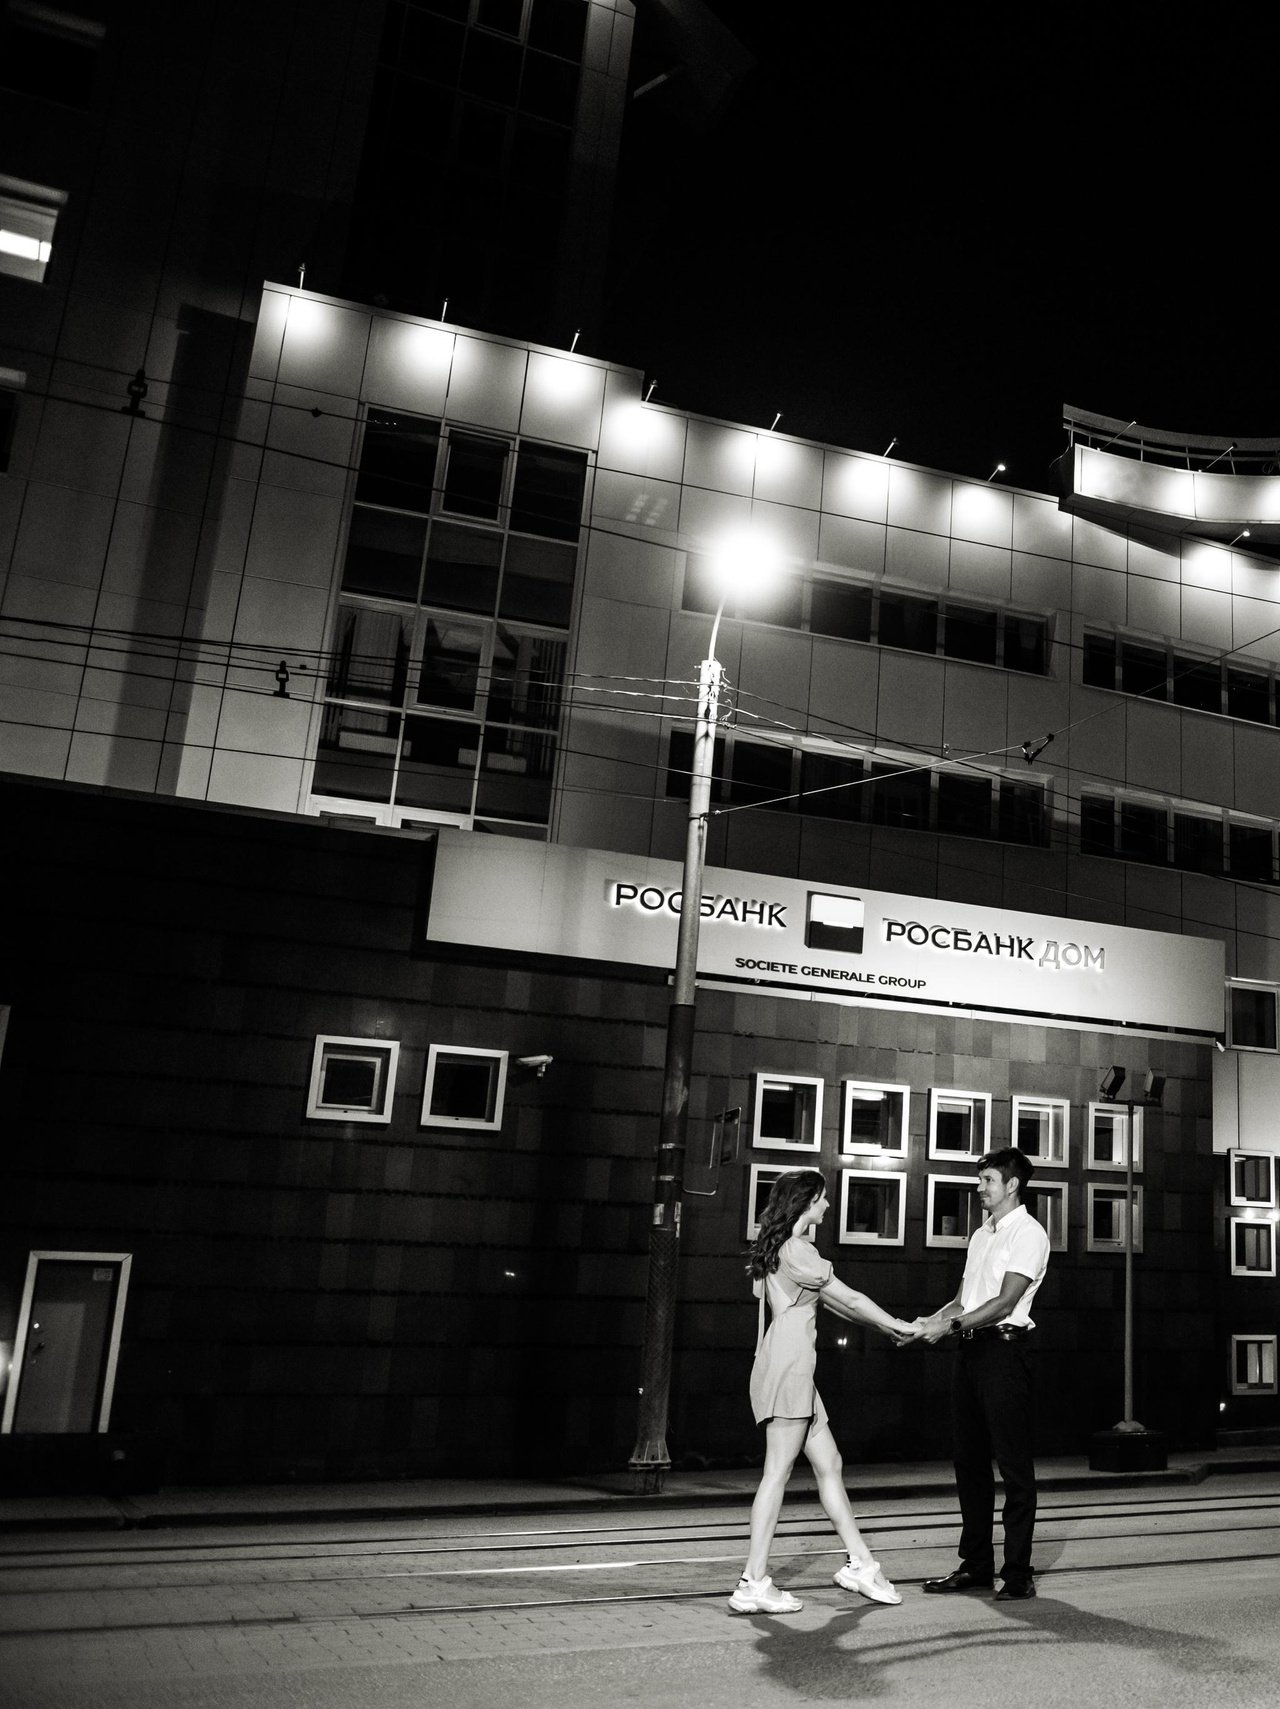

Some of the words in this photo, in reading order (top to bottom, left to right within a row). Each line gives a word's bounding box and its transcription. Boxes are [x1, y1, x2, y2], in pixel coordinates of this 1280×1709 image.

[614, 883, 788, 928] РОСБАНК
[885, 920, 1035, 961] РОСБАНК
[1038, 940, 1106, 970] ДОМ
[735, 957, 798, 975] SOCIETE
[800, 965, 876, 984] GENERALE
[878, 974, 927, 990] GROUP
